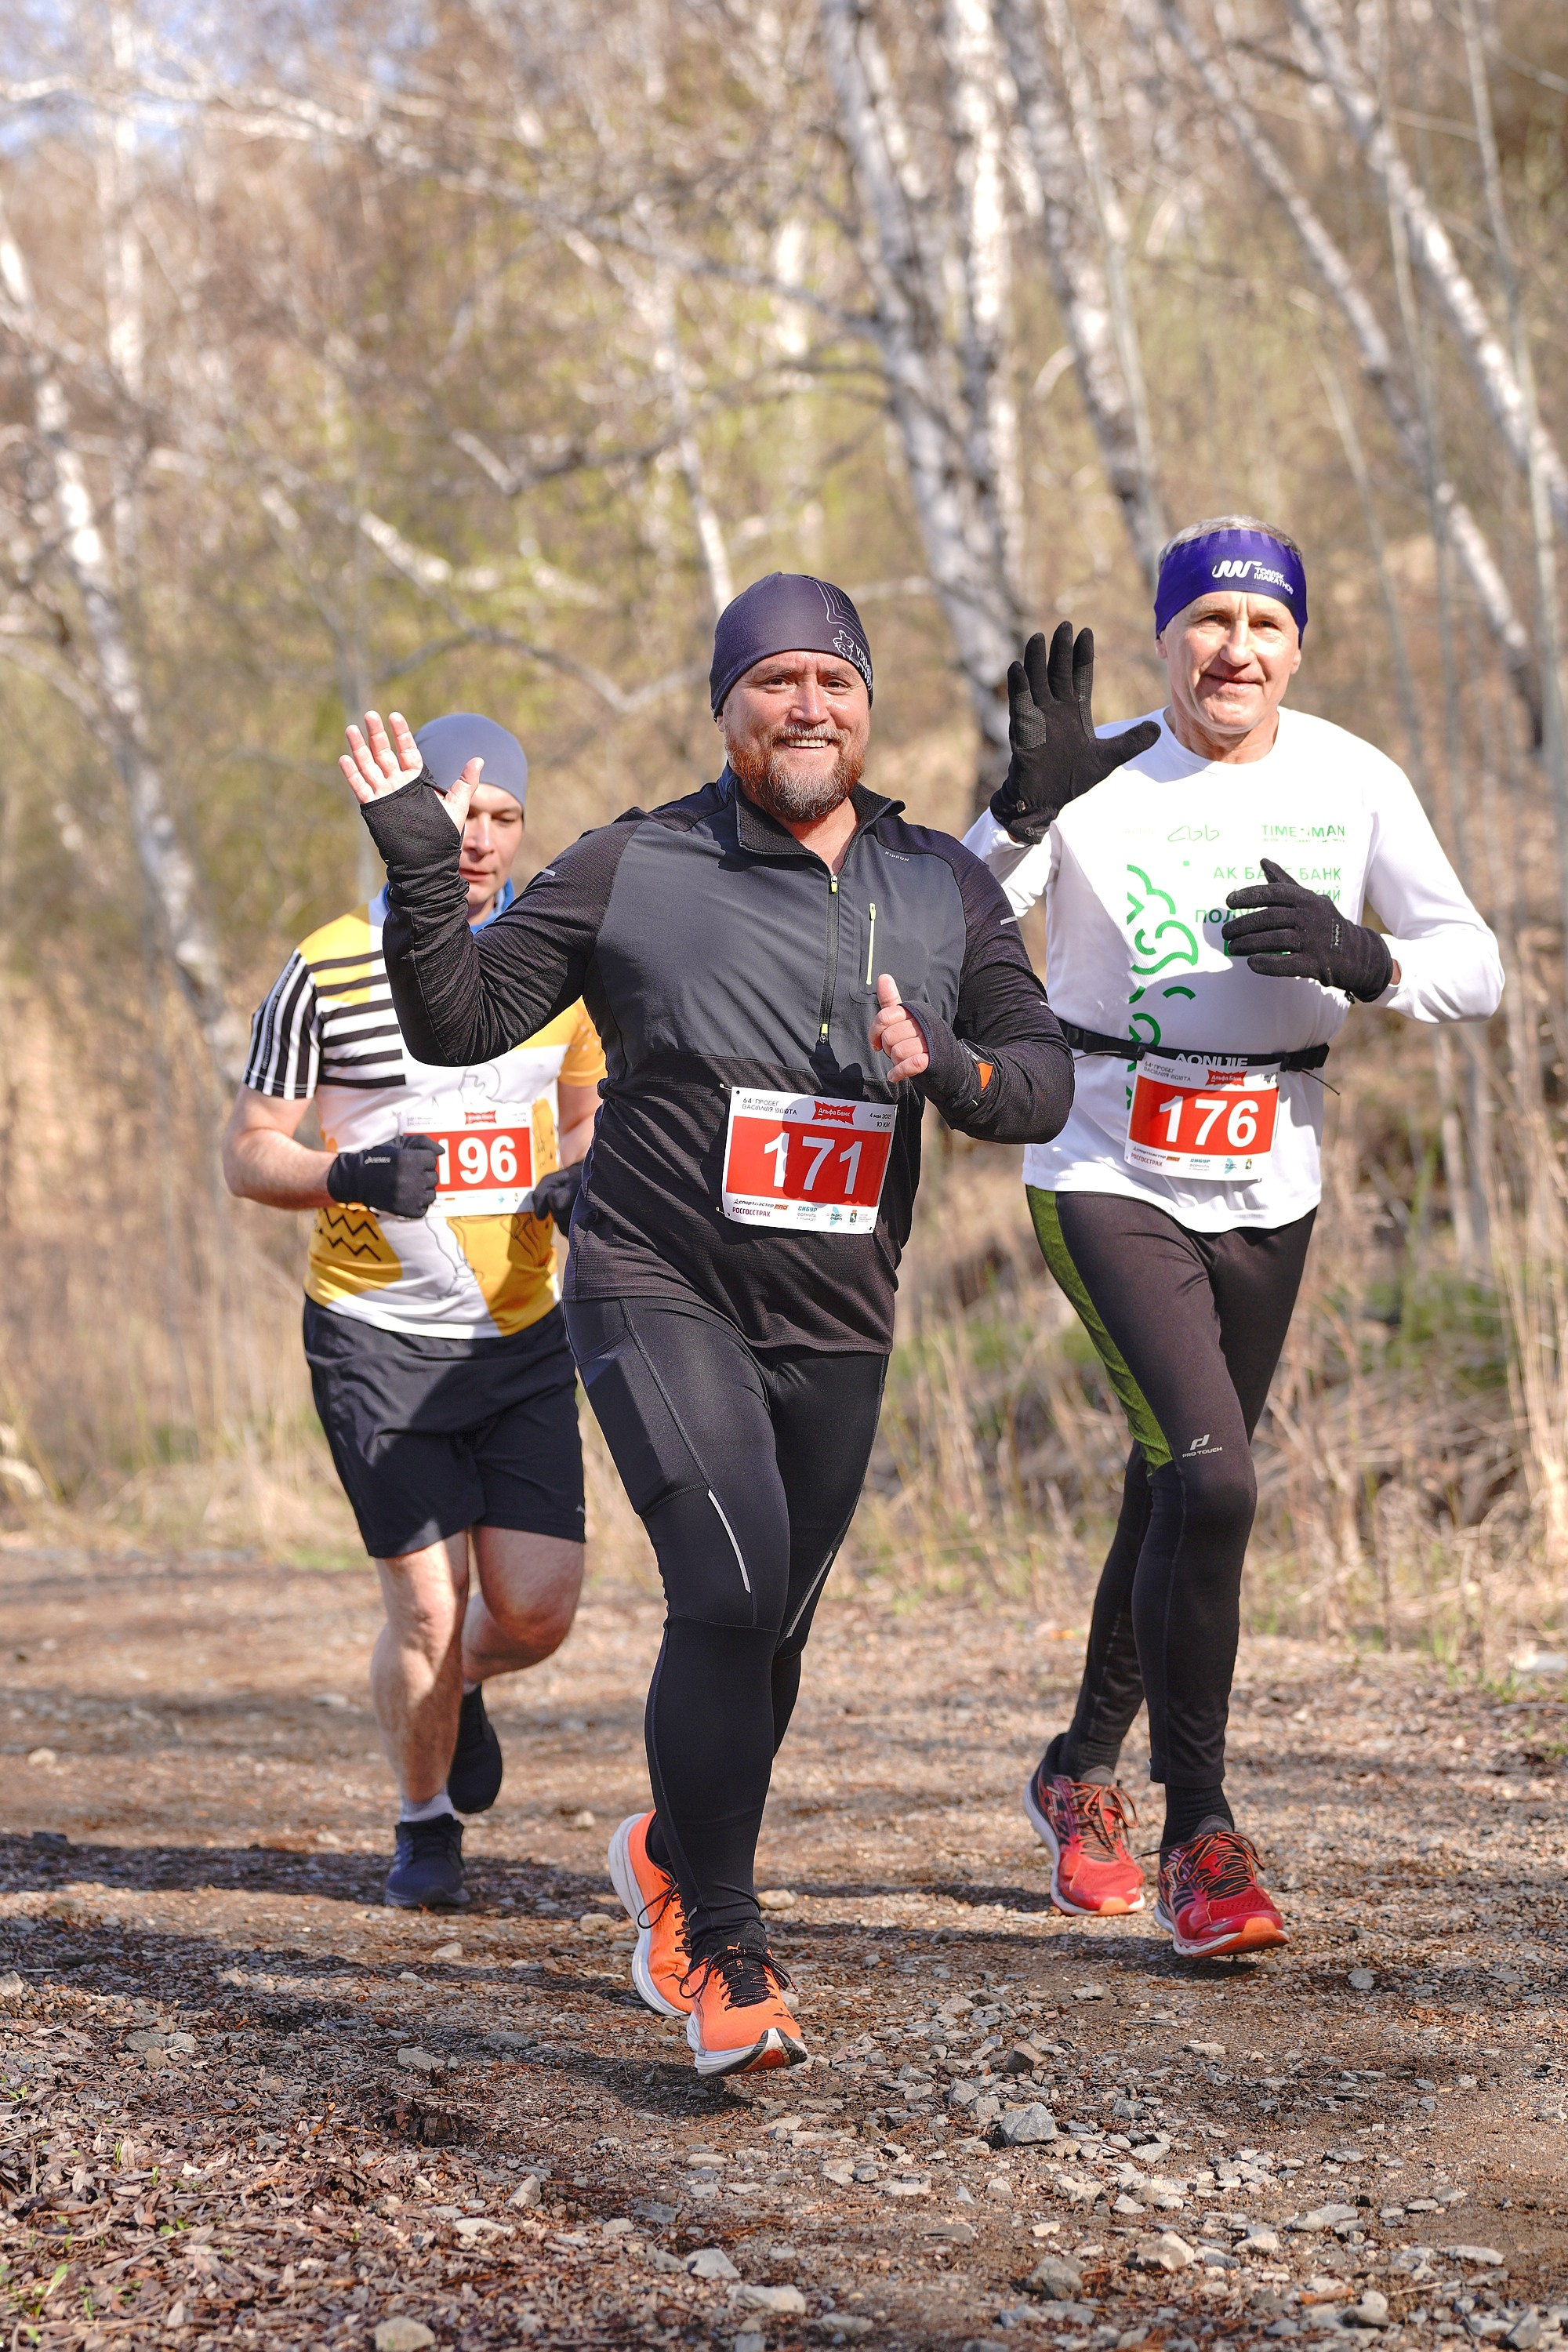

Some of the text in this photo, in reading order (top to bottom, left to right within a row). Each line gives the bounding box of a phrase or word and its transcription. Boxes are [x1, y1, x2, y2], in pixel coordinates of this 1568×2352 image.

[1255, 567, 1283, 580] TOMSK
[1254, 573, 1294, 595] MARATHON
[1214, 866, 1238, 880] АК
[1299, 867, 1341, 881] БАНК
[742, 1103, 774, 1112] ВАСИЛИЯ
[755, 1098, 780, 1107] ПРОБЕГ
[818, 1107, 837, 1116] Альфа
[1159, 1095, 1260, 1148] 176
[437, 1135, 517, 1185] 196
[763, 1131, 863, 1195] 171
[1131, 1152, 1163, 1167] РОСГОССТРАХ
[732, 1207, 771, 1218] РОСГОССТРАХ
